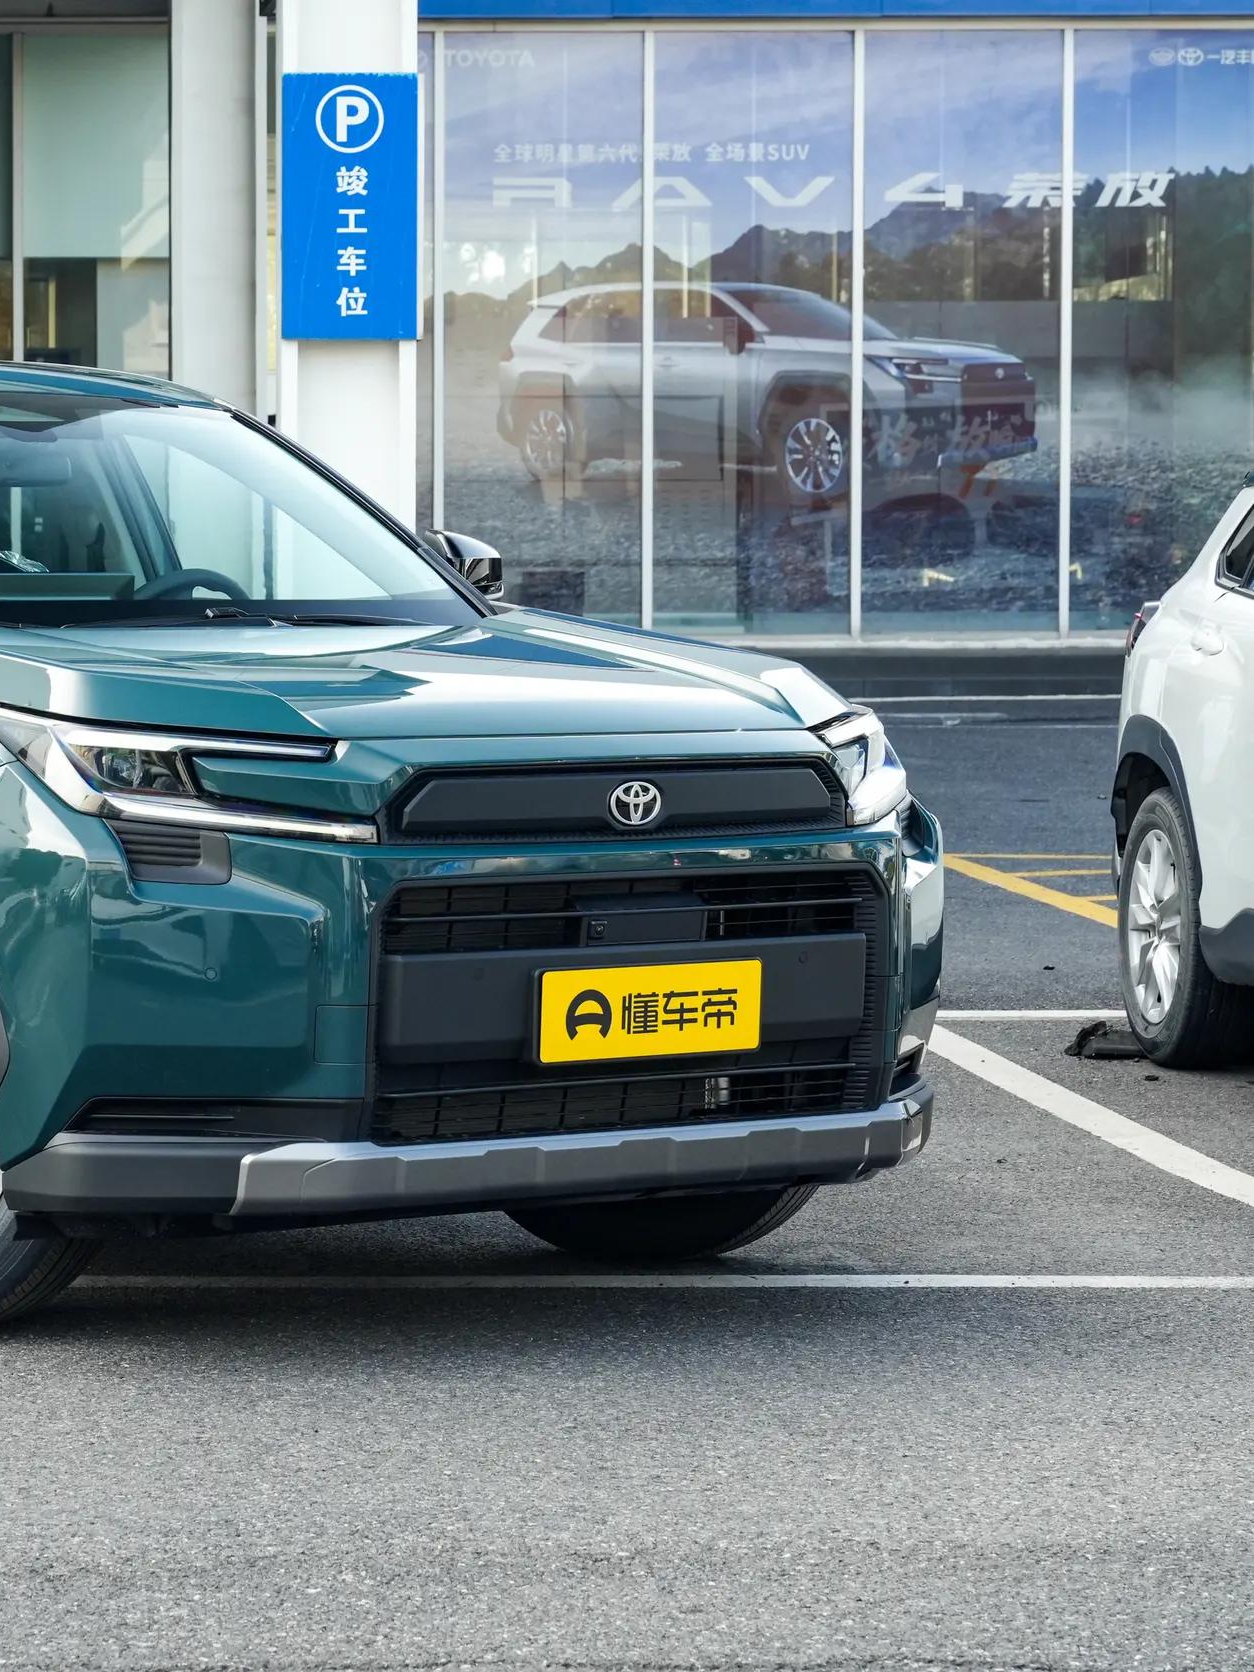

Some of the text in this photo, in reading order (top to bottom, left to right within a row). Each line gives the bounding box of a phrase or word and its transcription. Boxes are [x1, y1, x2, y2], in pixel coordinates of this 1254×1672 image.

[444, 48, 535, 68] TOYOTA
[1206, 48, 1254, 65] 一汽丰
[336, 96, 370, 142] P
[335, 165, 369, 317] 竣工车位
[621, 988, 738, 1035] 懂车帝
